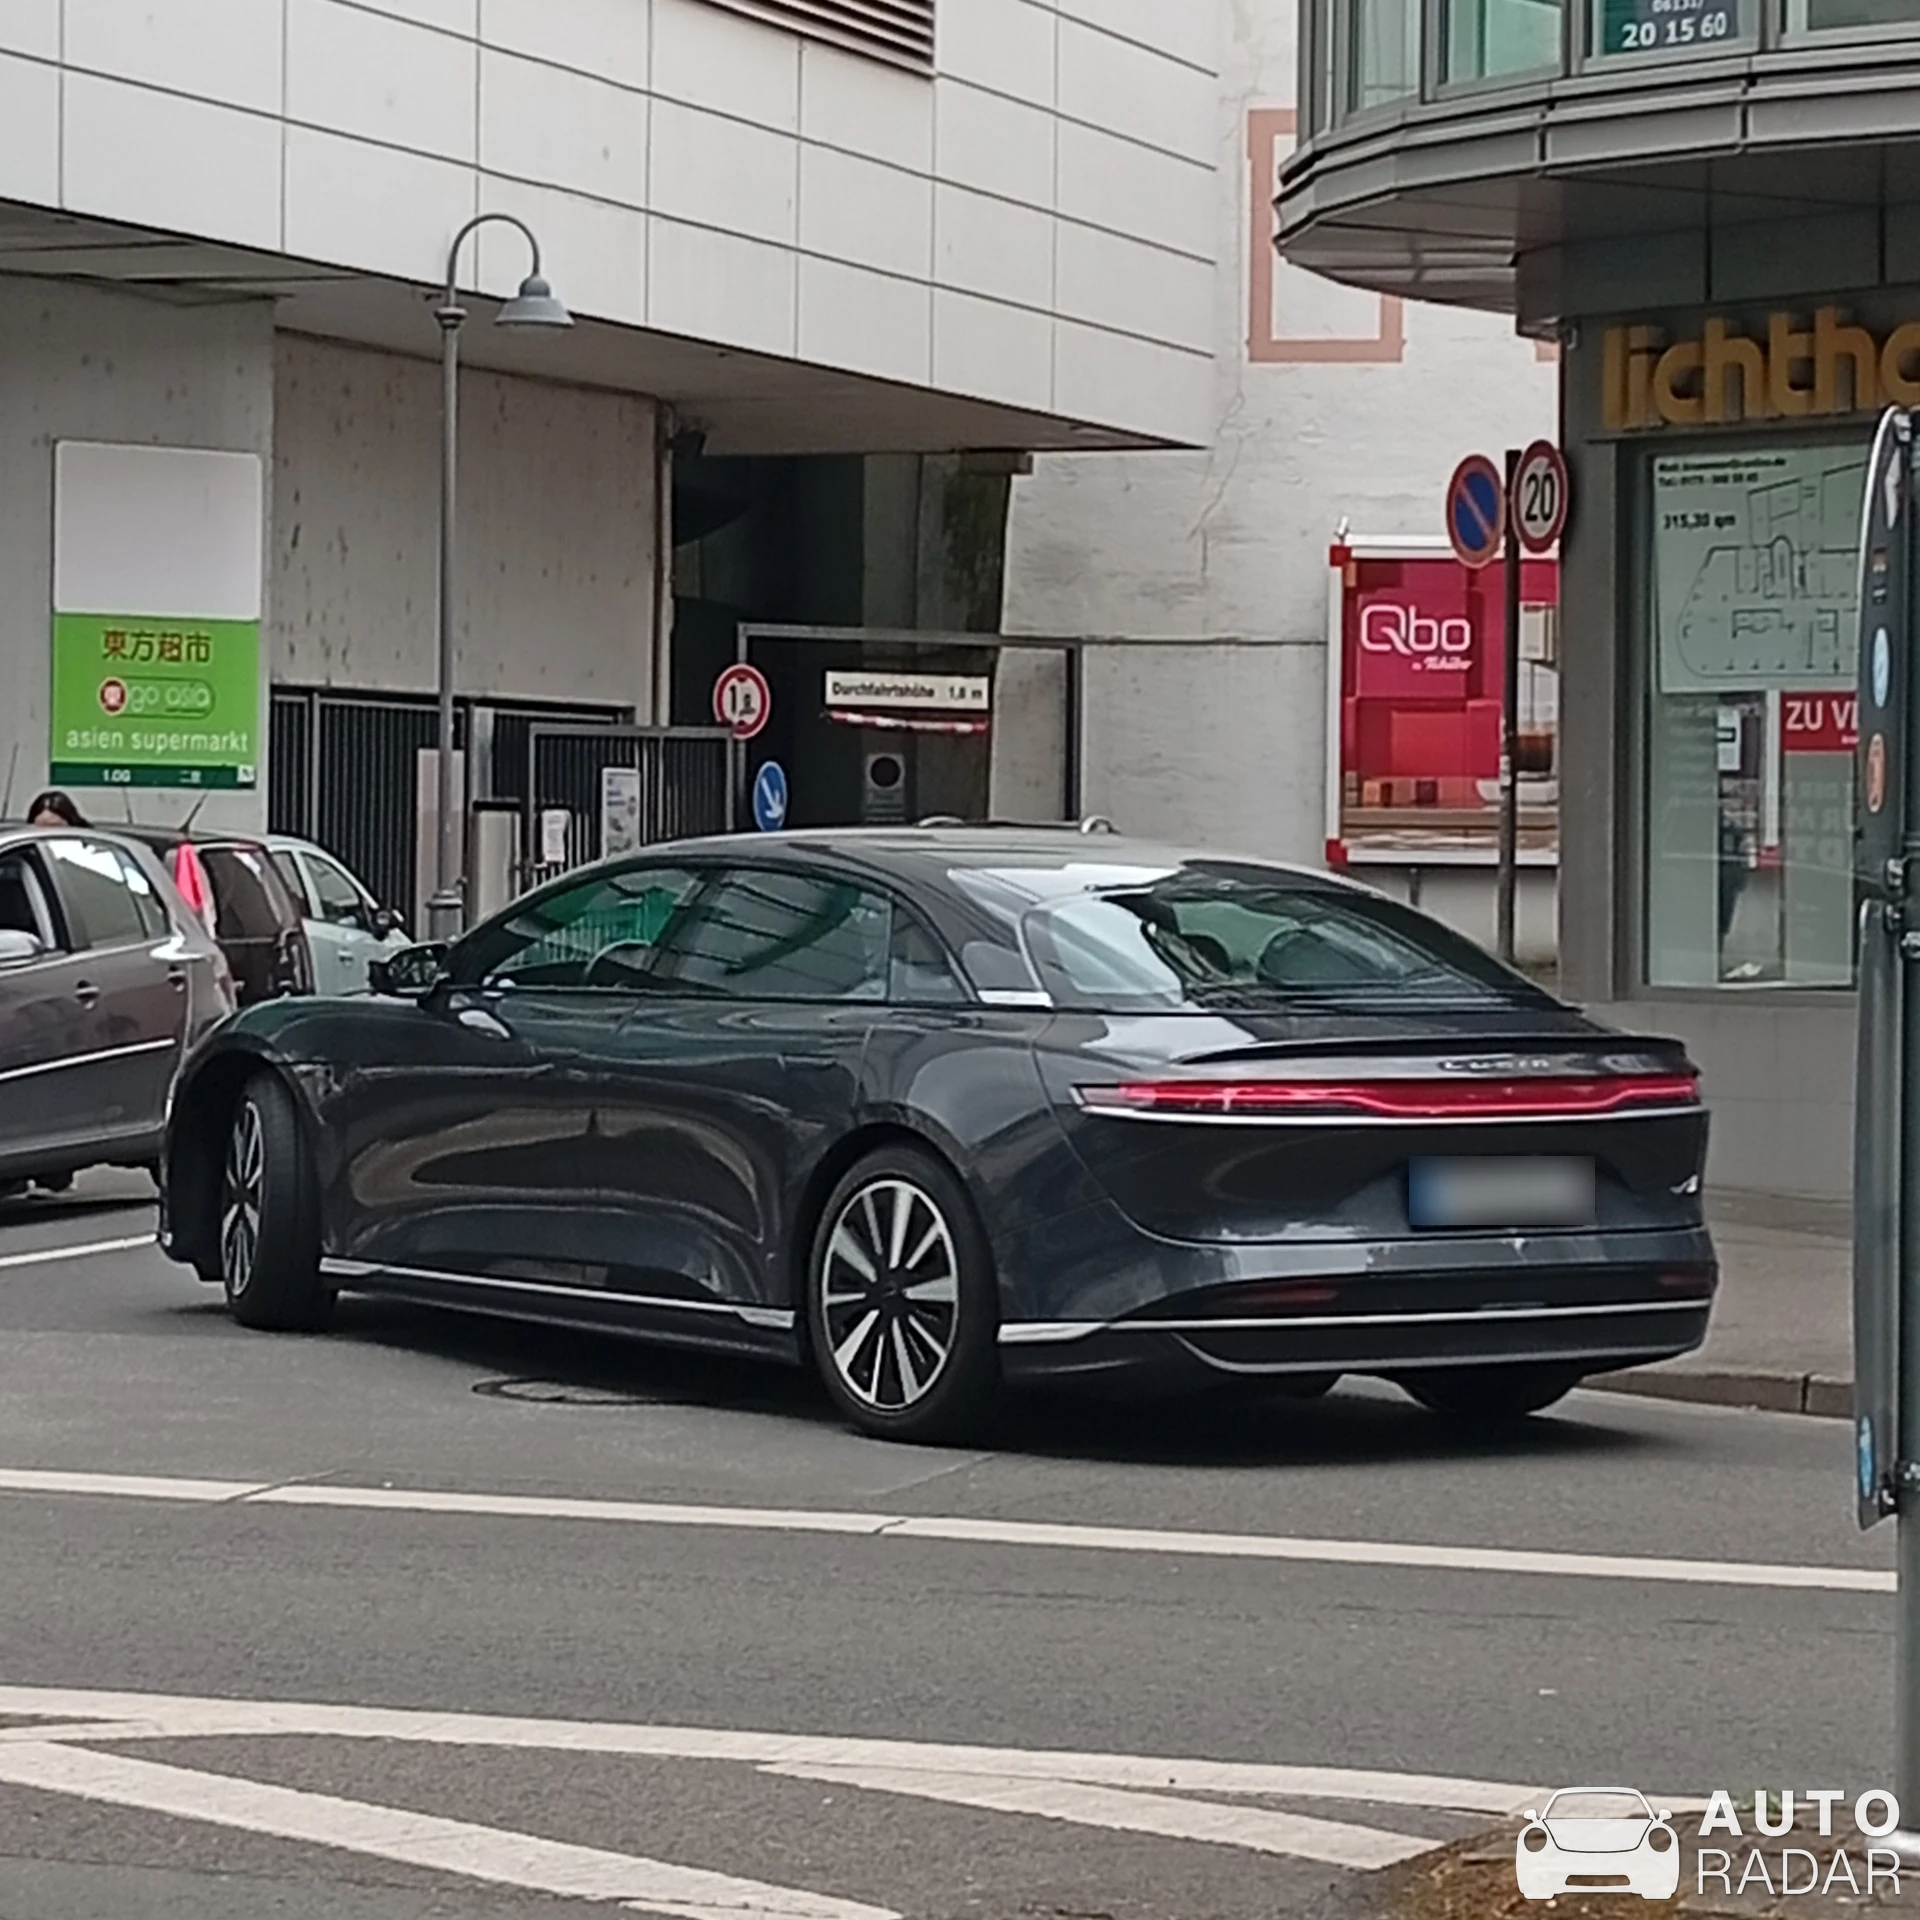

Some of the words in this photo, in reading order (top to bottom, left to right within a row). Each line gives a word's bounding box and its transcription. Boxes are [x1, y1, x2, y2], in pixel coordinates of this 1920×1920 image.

[1621, 22, 1657, 48] 20
[1665, 17, 1696, 44] 15
[1700, 12, 1727, 39] 60
[1525, 472, 1555, 523] 20
[1361, 605, 1471, 655] Qbo
[102, 631, 211, 662] 東方超市
[129, 686, 160, 712] go
[832, 682, 935, 699] Durchfahrtshöhe
[971, 690, 983, 699] m
[1786, 701, 1823, 731] ZU
[66, 728, 123, 748] asien
[131, 731, 248, 754] supermarkt
